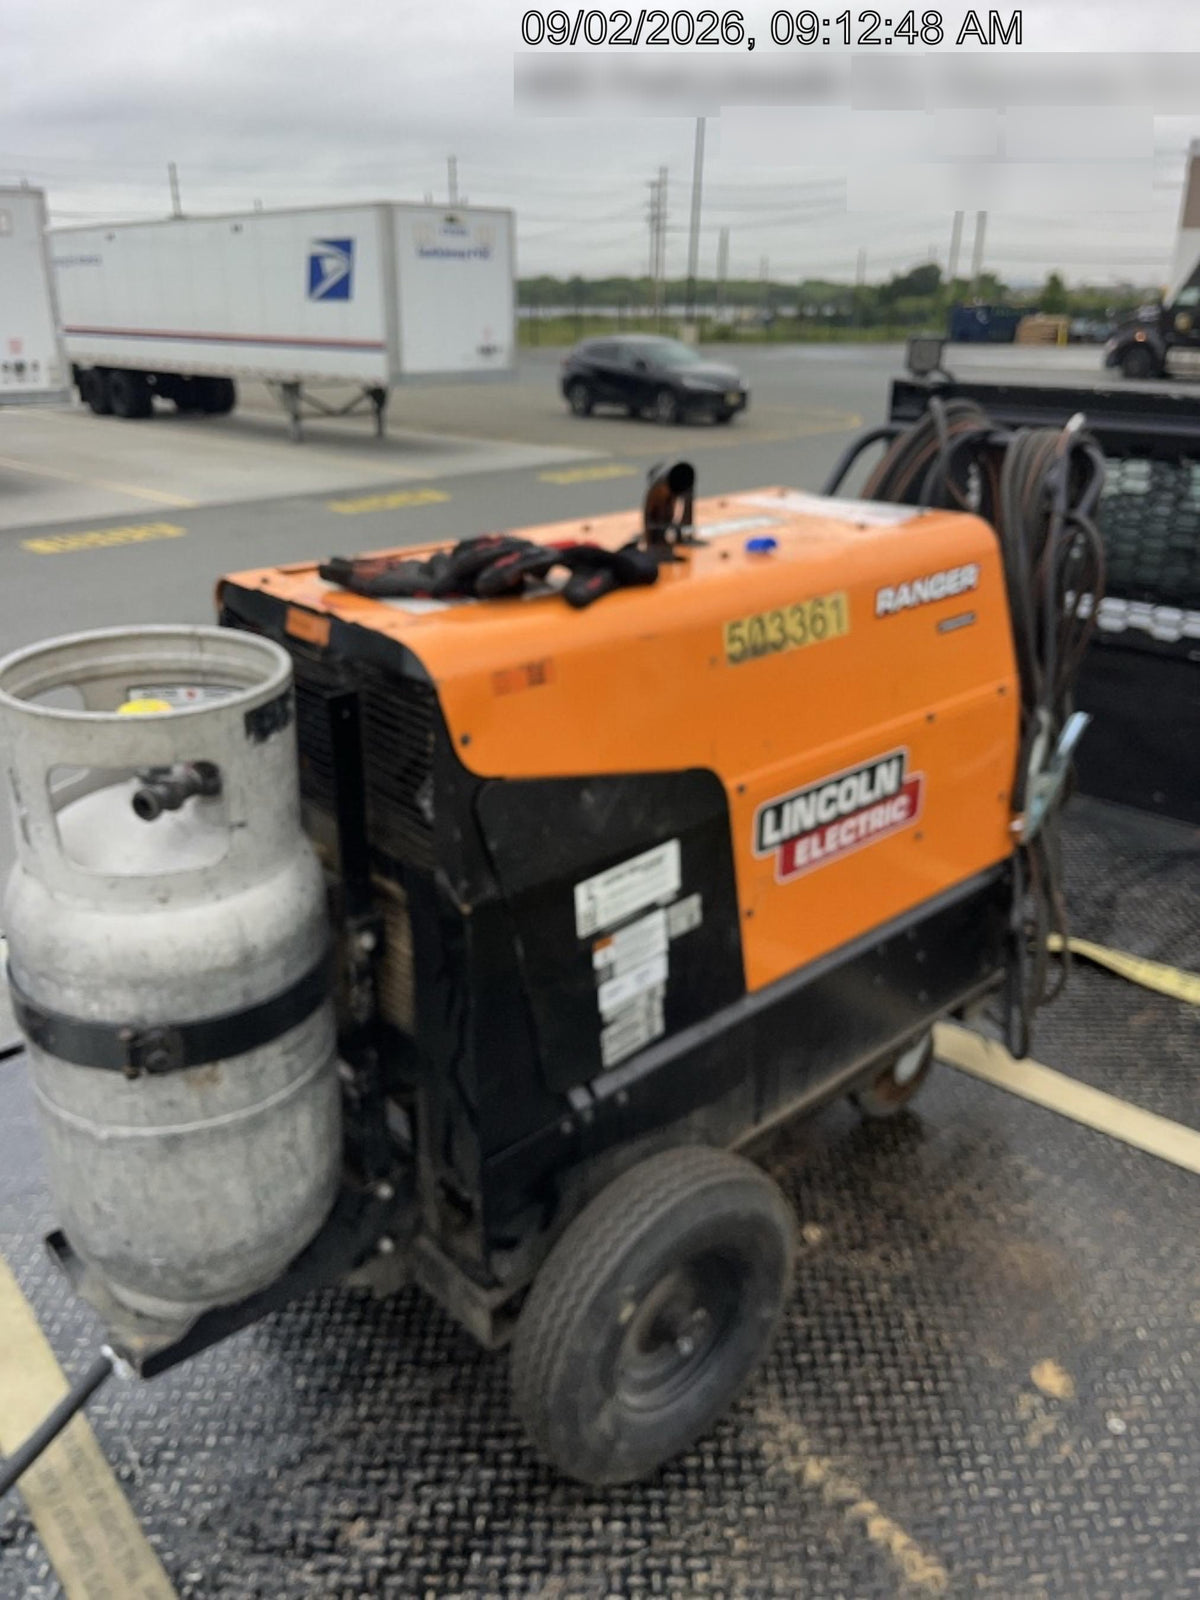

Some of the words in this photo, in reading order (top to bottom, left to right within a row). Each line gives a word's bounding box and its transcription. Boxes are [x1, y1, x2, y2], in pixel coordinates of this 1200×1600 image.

[875, 564, 978, 616] RANGER
[727, 596, 846, 664] 503361
[761, 757, 901, 846] LINCOLN
[793, 793, 911, 868] ELECTRIC
